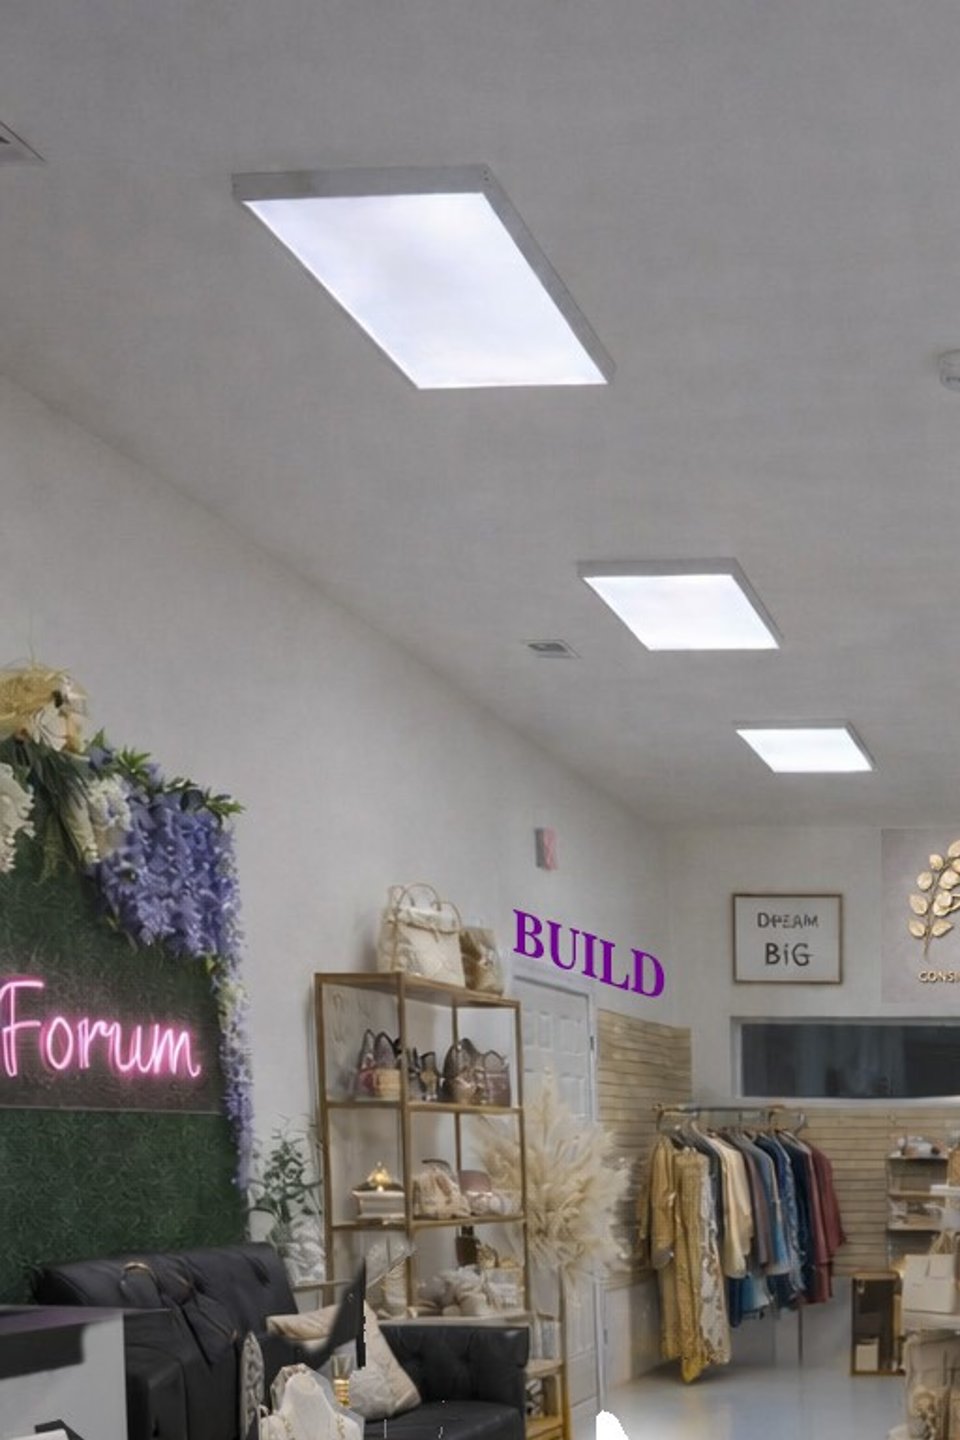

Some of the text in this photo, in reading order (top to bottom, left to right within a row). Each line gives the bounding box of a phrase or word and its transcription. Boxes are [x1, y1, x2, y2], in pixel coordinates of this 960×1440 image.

[513, 908, 665, 997] BUILD
[757, 912, 819, 929] DREAM
[0, 980, 201, 1077] Forum
